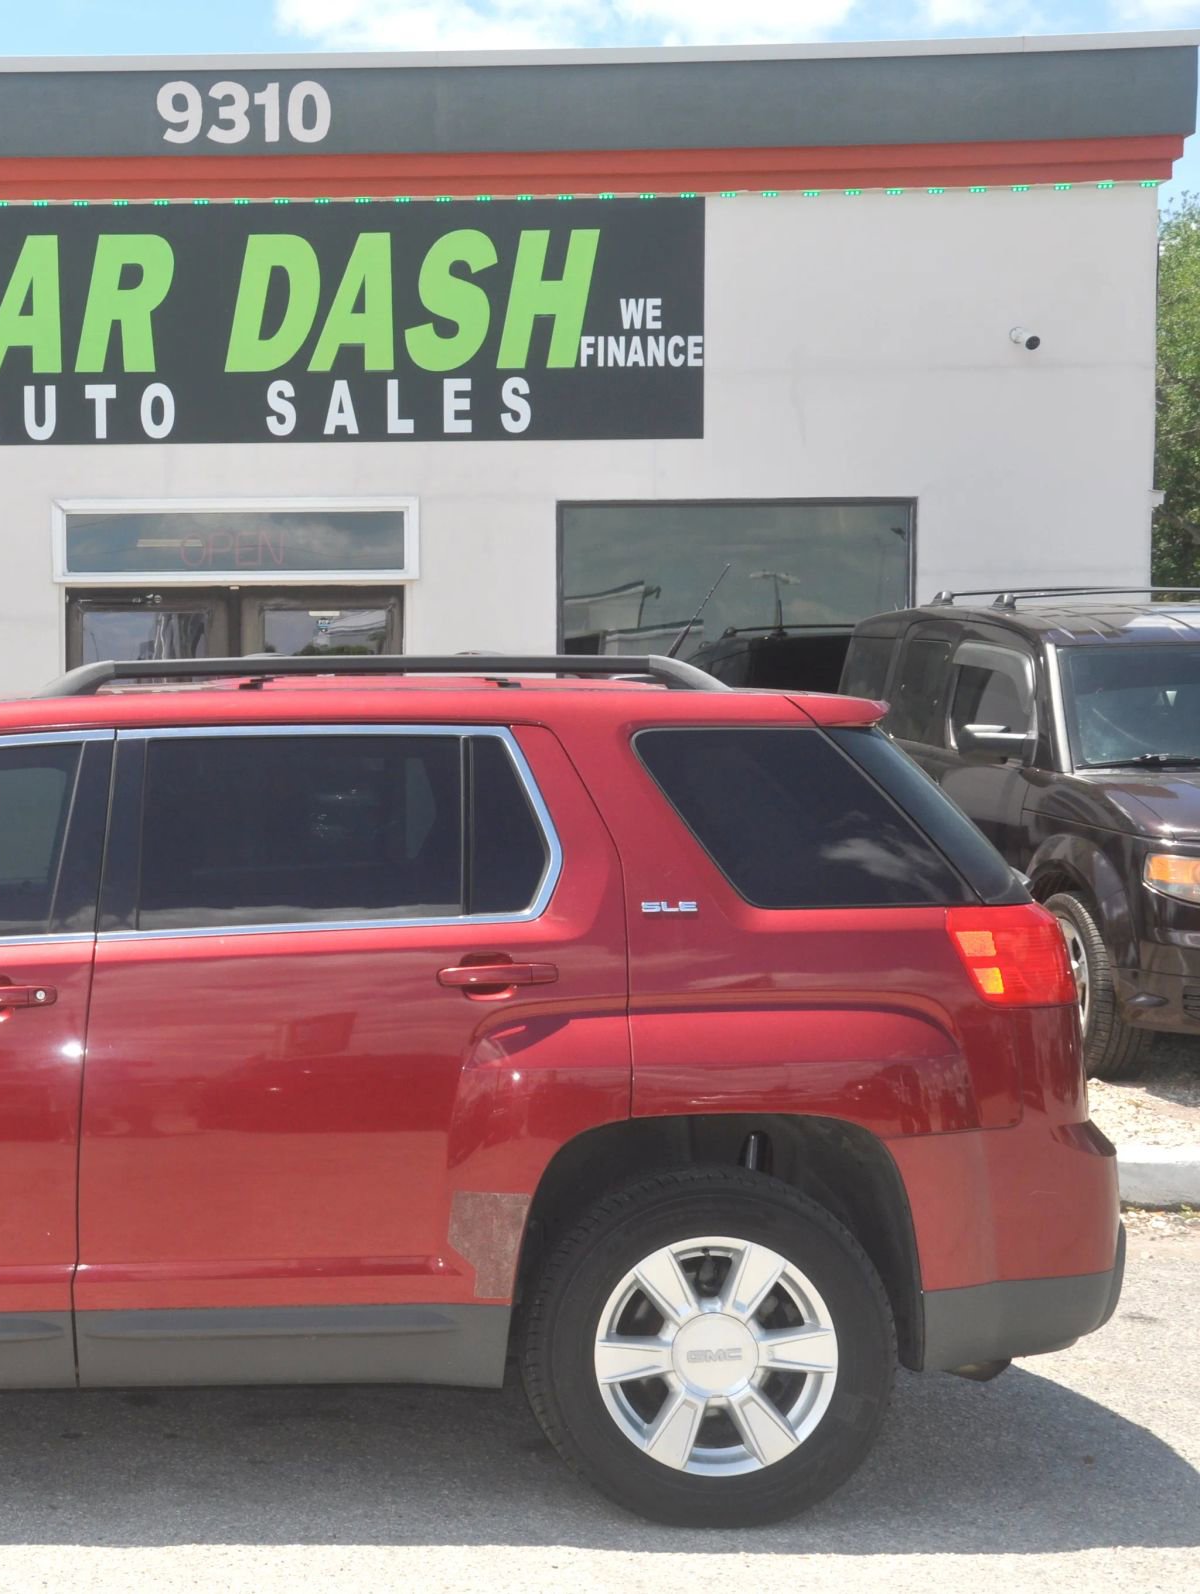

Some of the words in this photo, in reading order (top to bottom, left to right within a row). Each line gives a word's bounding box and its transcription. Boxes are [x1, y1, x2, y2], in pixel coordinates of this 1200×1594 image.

[156, 80, 332, 145] 9310
[224, 228, 601, 373] DASH
[619, 297, 662, 330] WE
[580, 334, 704, 367] FINANCE
[265, 376, 533, 438] SALES
[179, 531, 286, 566] OPEN
[641, 901, 698, 913] SLE
[686, 1347, 743, 1363] GMC
